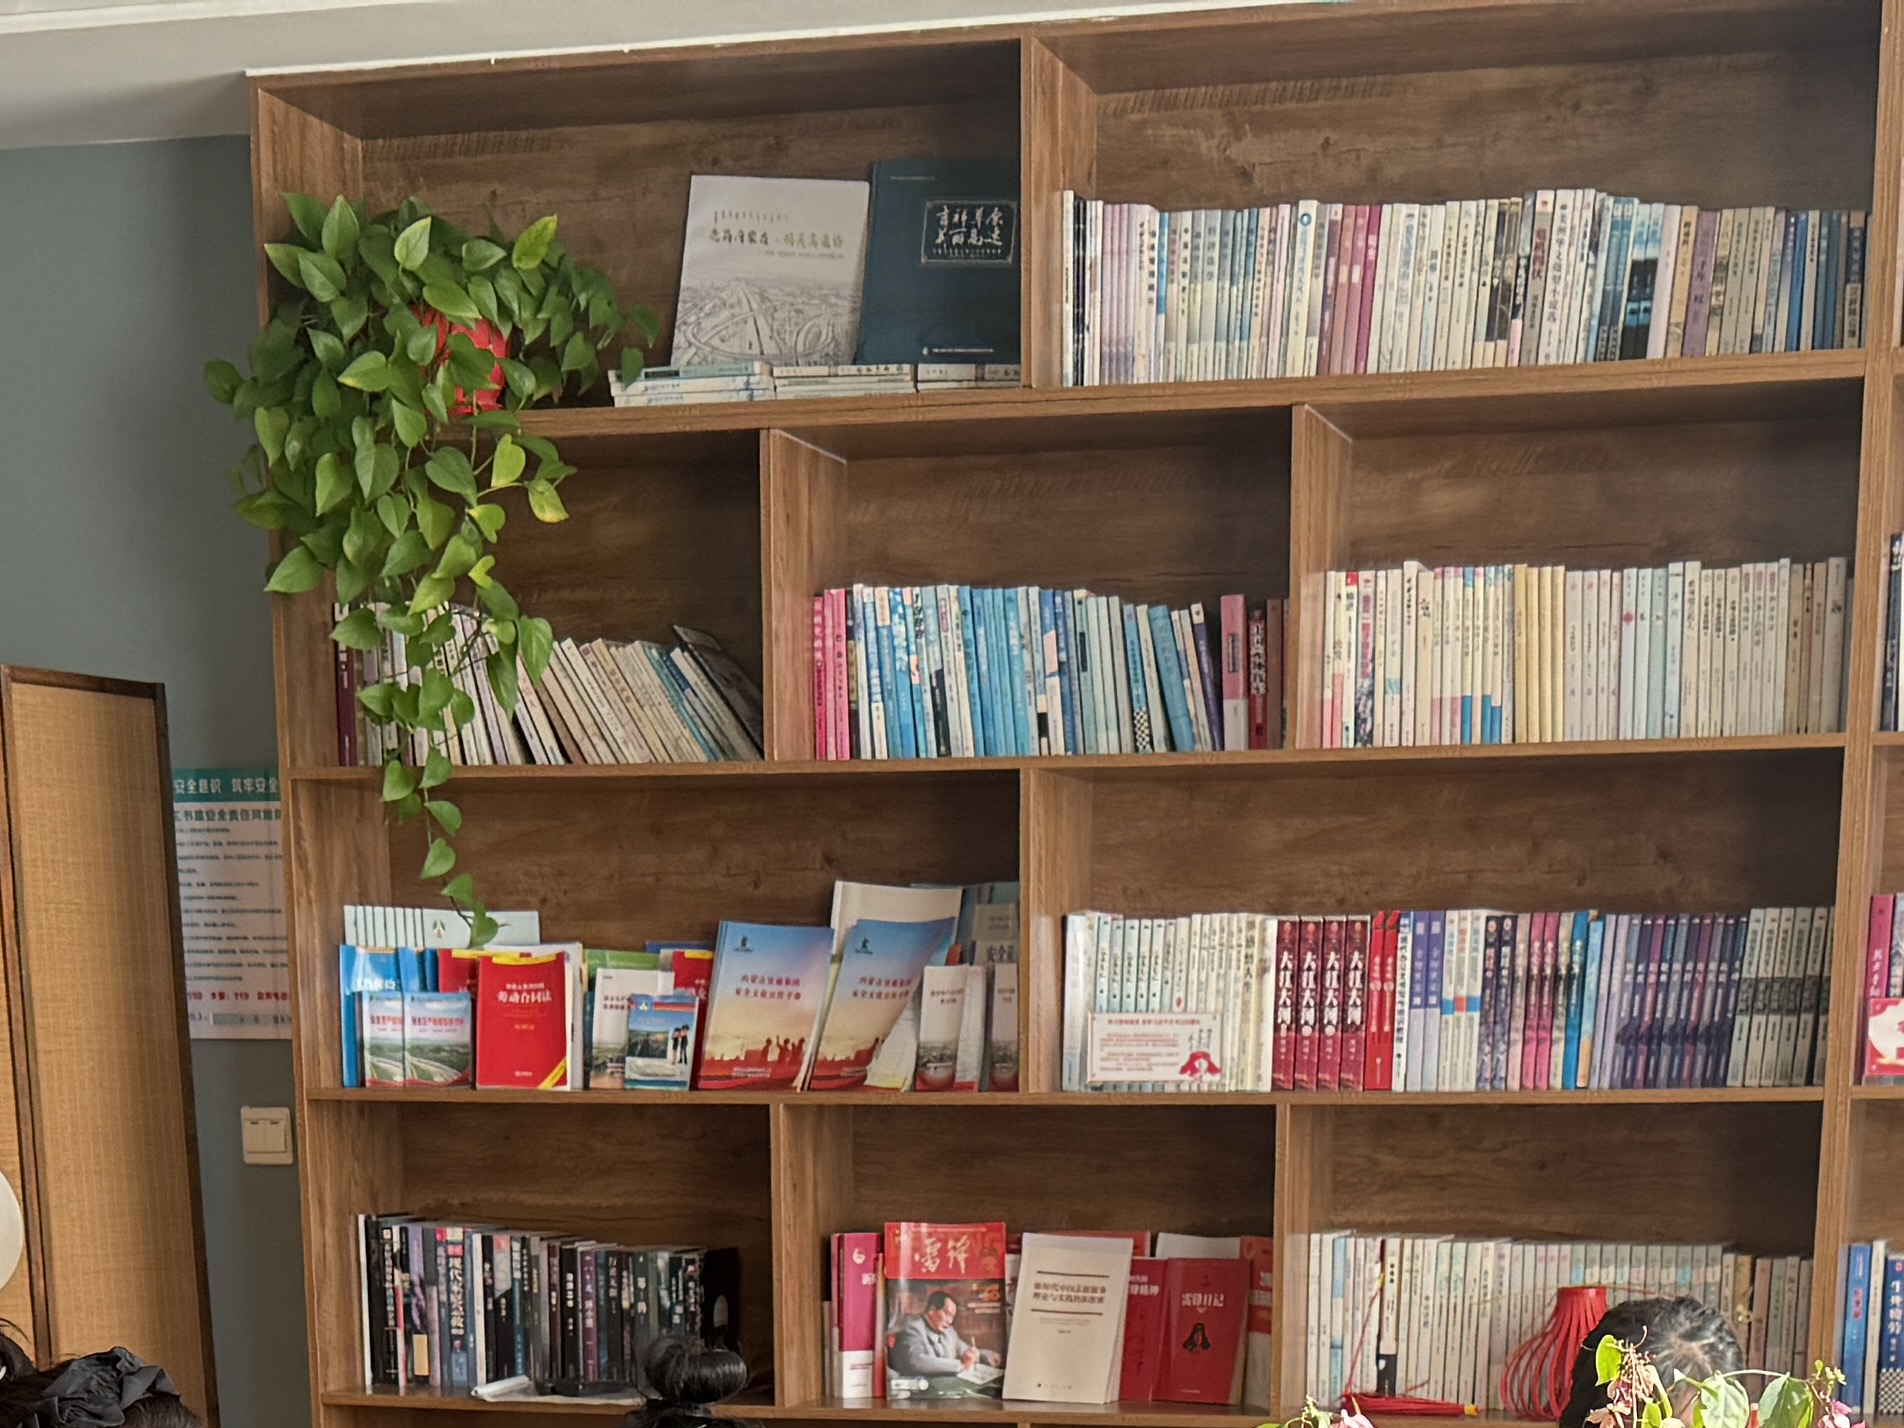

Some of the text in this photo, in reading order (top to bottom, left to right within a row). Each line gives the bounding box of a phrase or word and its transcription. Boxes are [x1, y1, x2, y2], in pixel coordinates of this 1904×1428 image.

[1278, 950, 1294, 1025] 大江大河
[1301, 950, 1316, 1025] 大江大河
[1324, 950, 1339, 1025] 大江大河
[1347, 950, 1363, 1025] 大江大河
[913, 1235, 971, 1275] 雷锋
